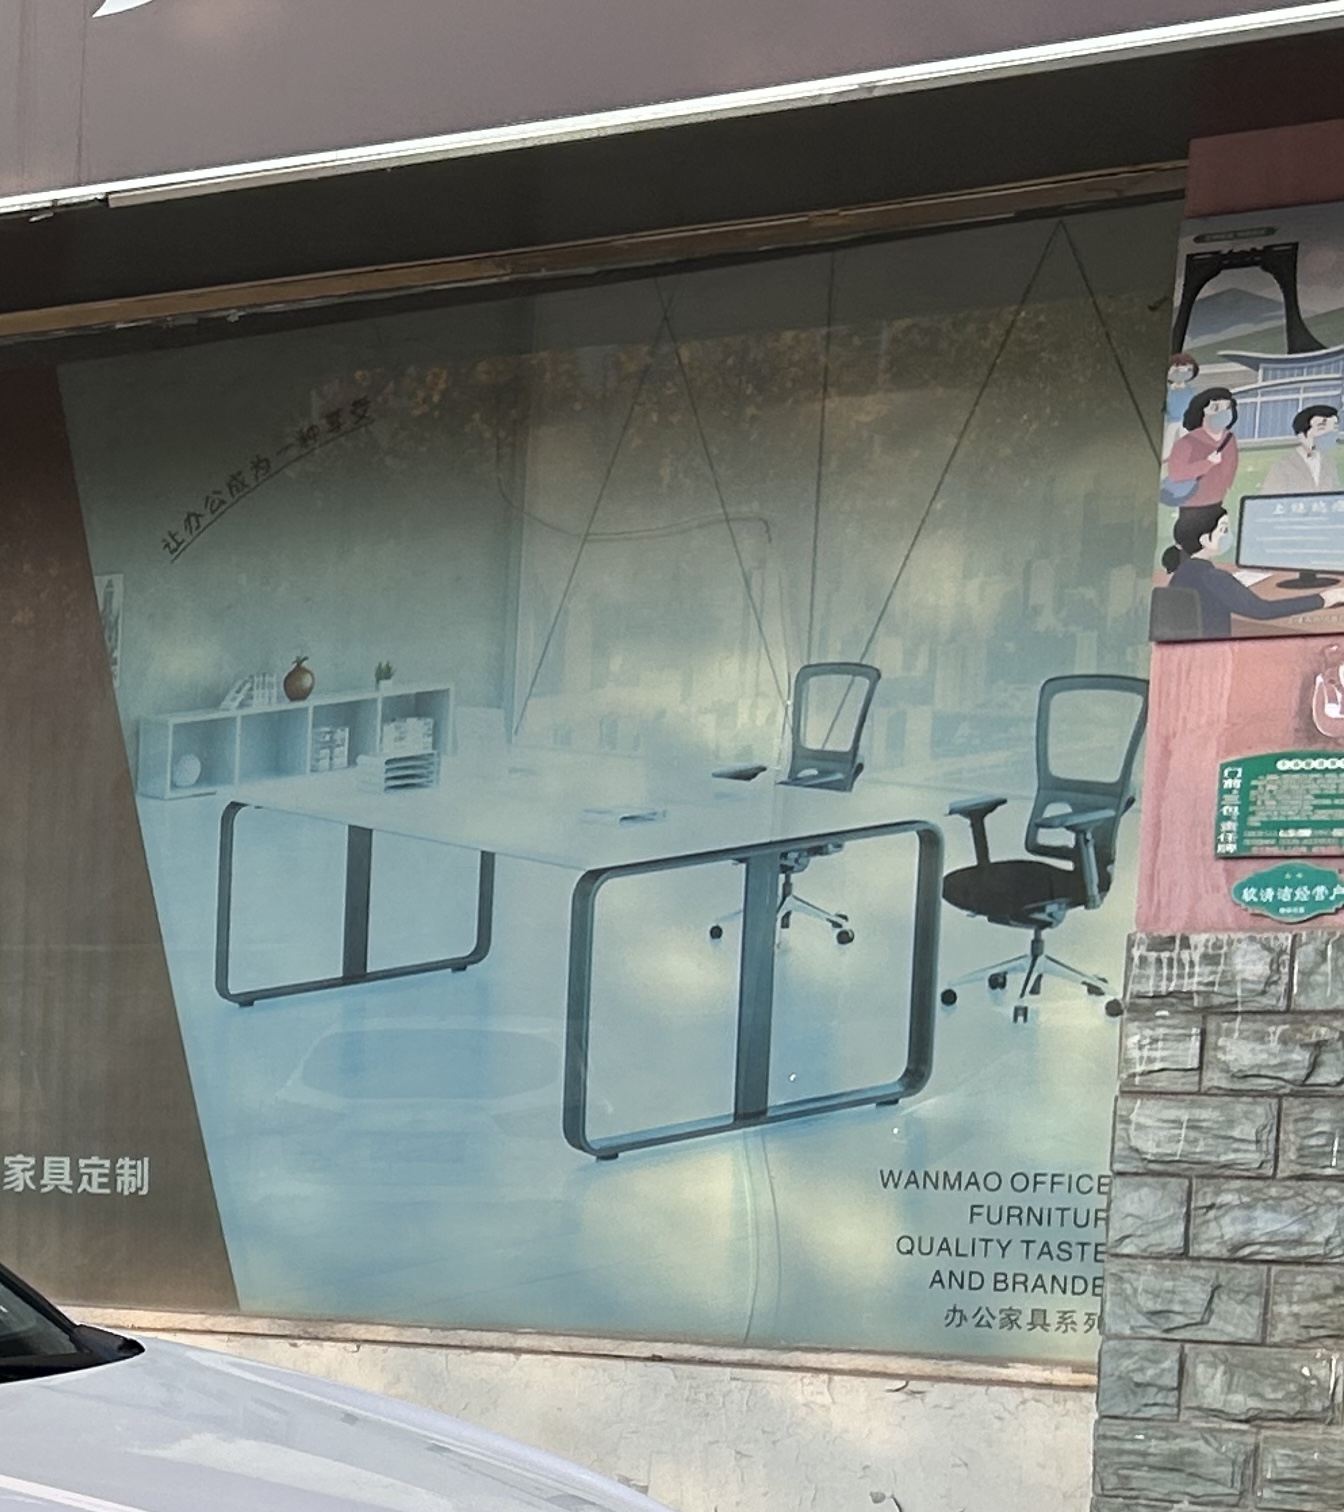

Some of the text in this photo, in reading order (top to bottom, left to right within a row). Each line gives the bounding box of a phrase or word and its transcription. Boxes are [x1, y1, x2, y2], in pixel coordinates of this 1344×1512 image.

[879, 1169, 1112, 1196] WANMAO OFFICE
[895, 1235, 1107, 1264] QUALITY TASTE
[928, 1269, 985, 1292] AND
